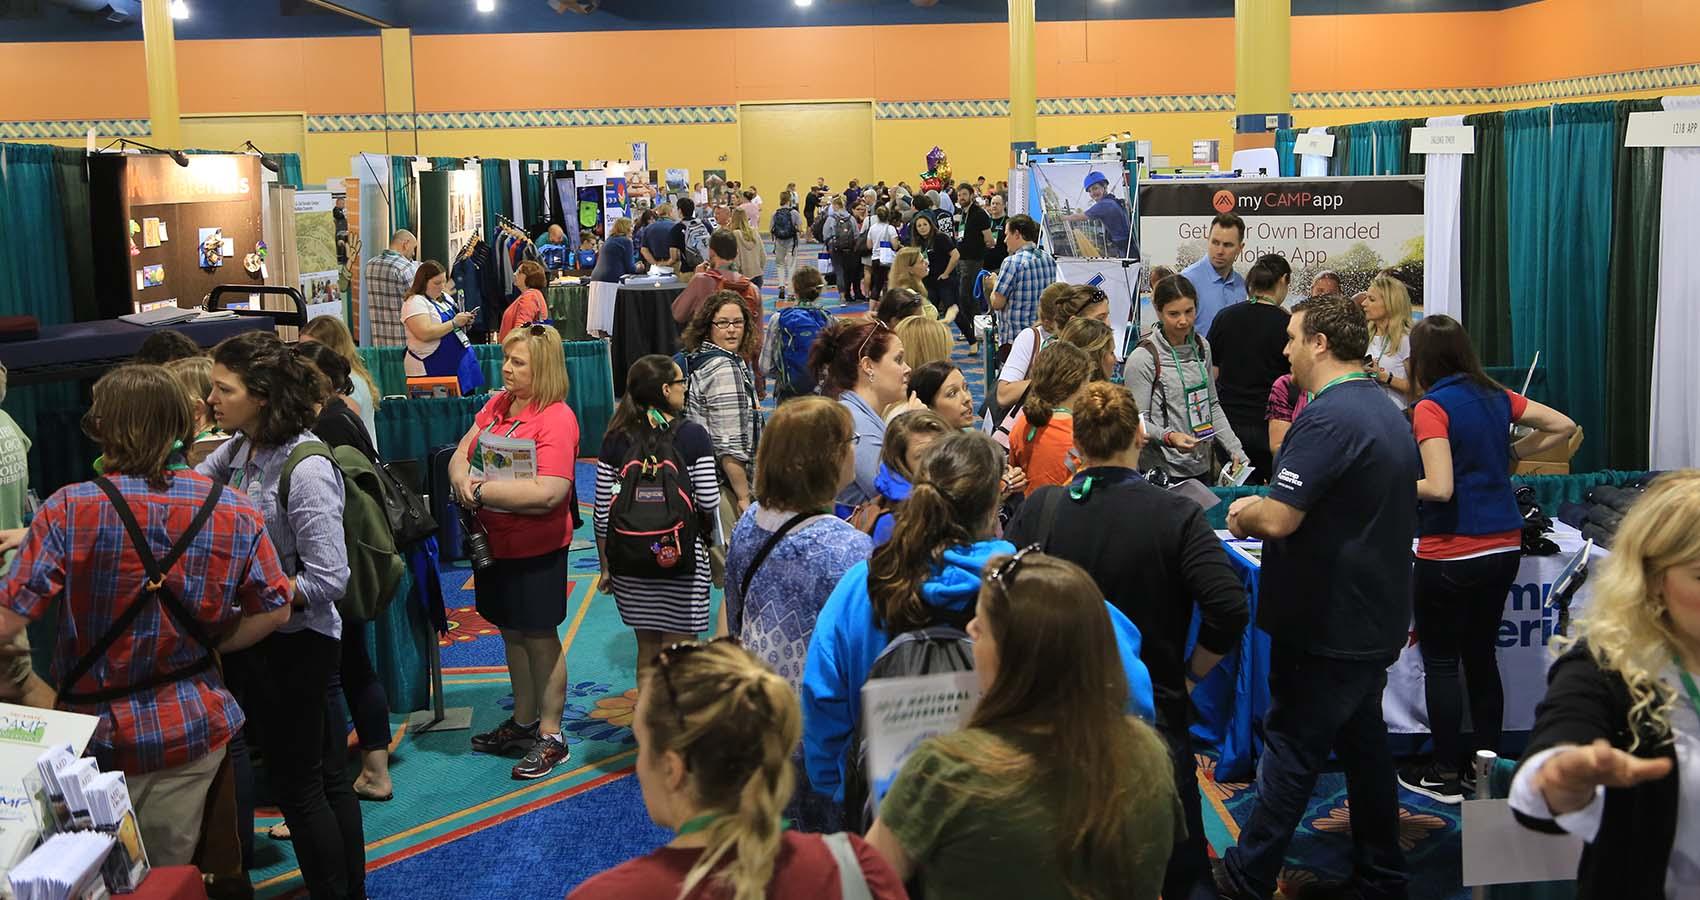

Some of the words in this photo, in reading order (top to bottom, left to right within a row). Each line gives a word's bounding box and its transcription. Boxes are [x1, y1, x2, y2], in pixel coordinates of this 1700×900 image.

[1178, 222, 1208, 240] Get
[1258, 222, 1297, 240] Own
[1303, 221, 1380, 240] Branded
[1291, 247, 1327, 267] App
